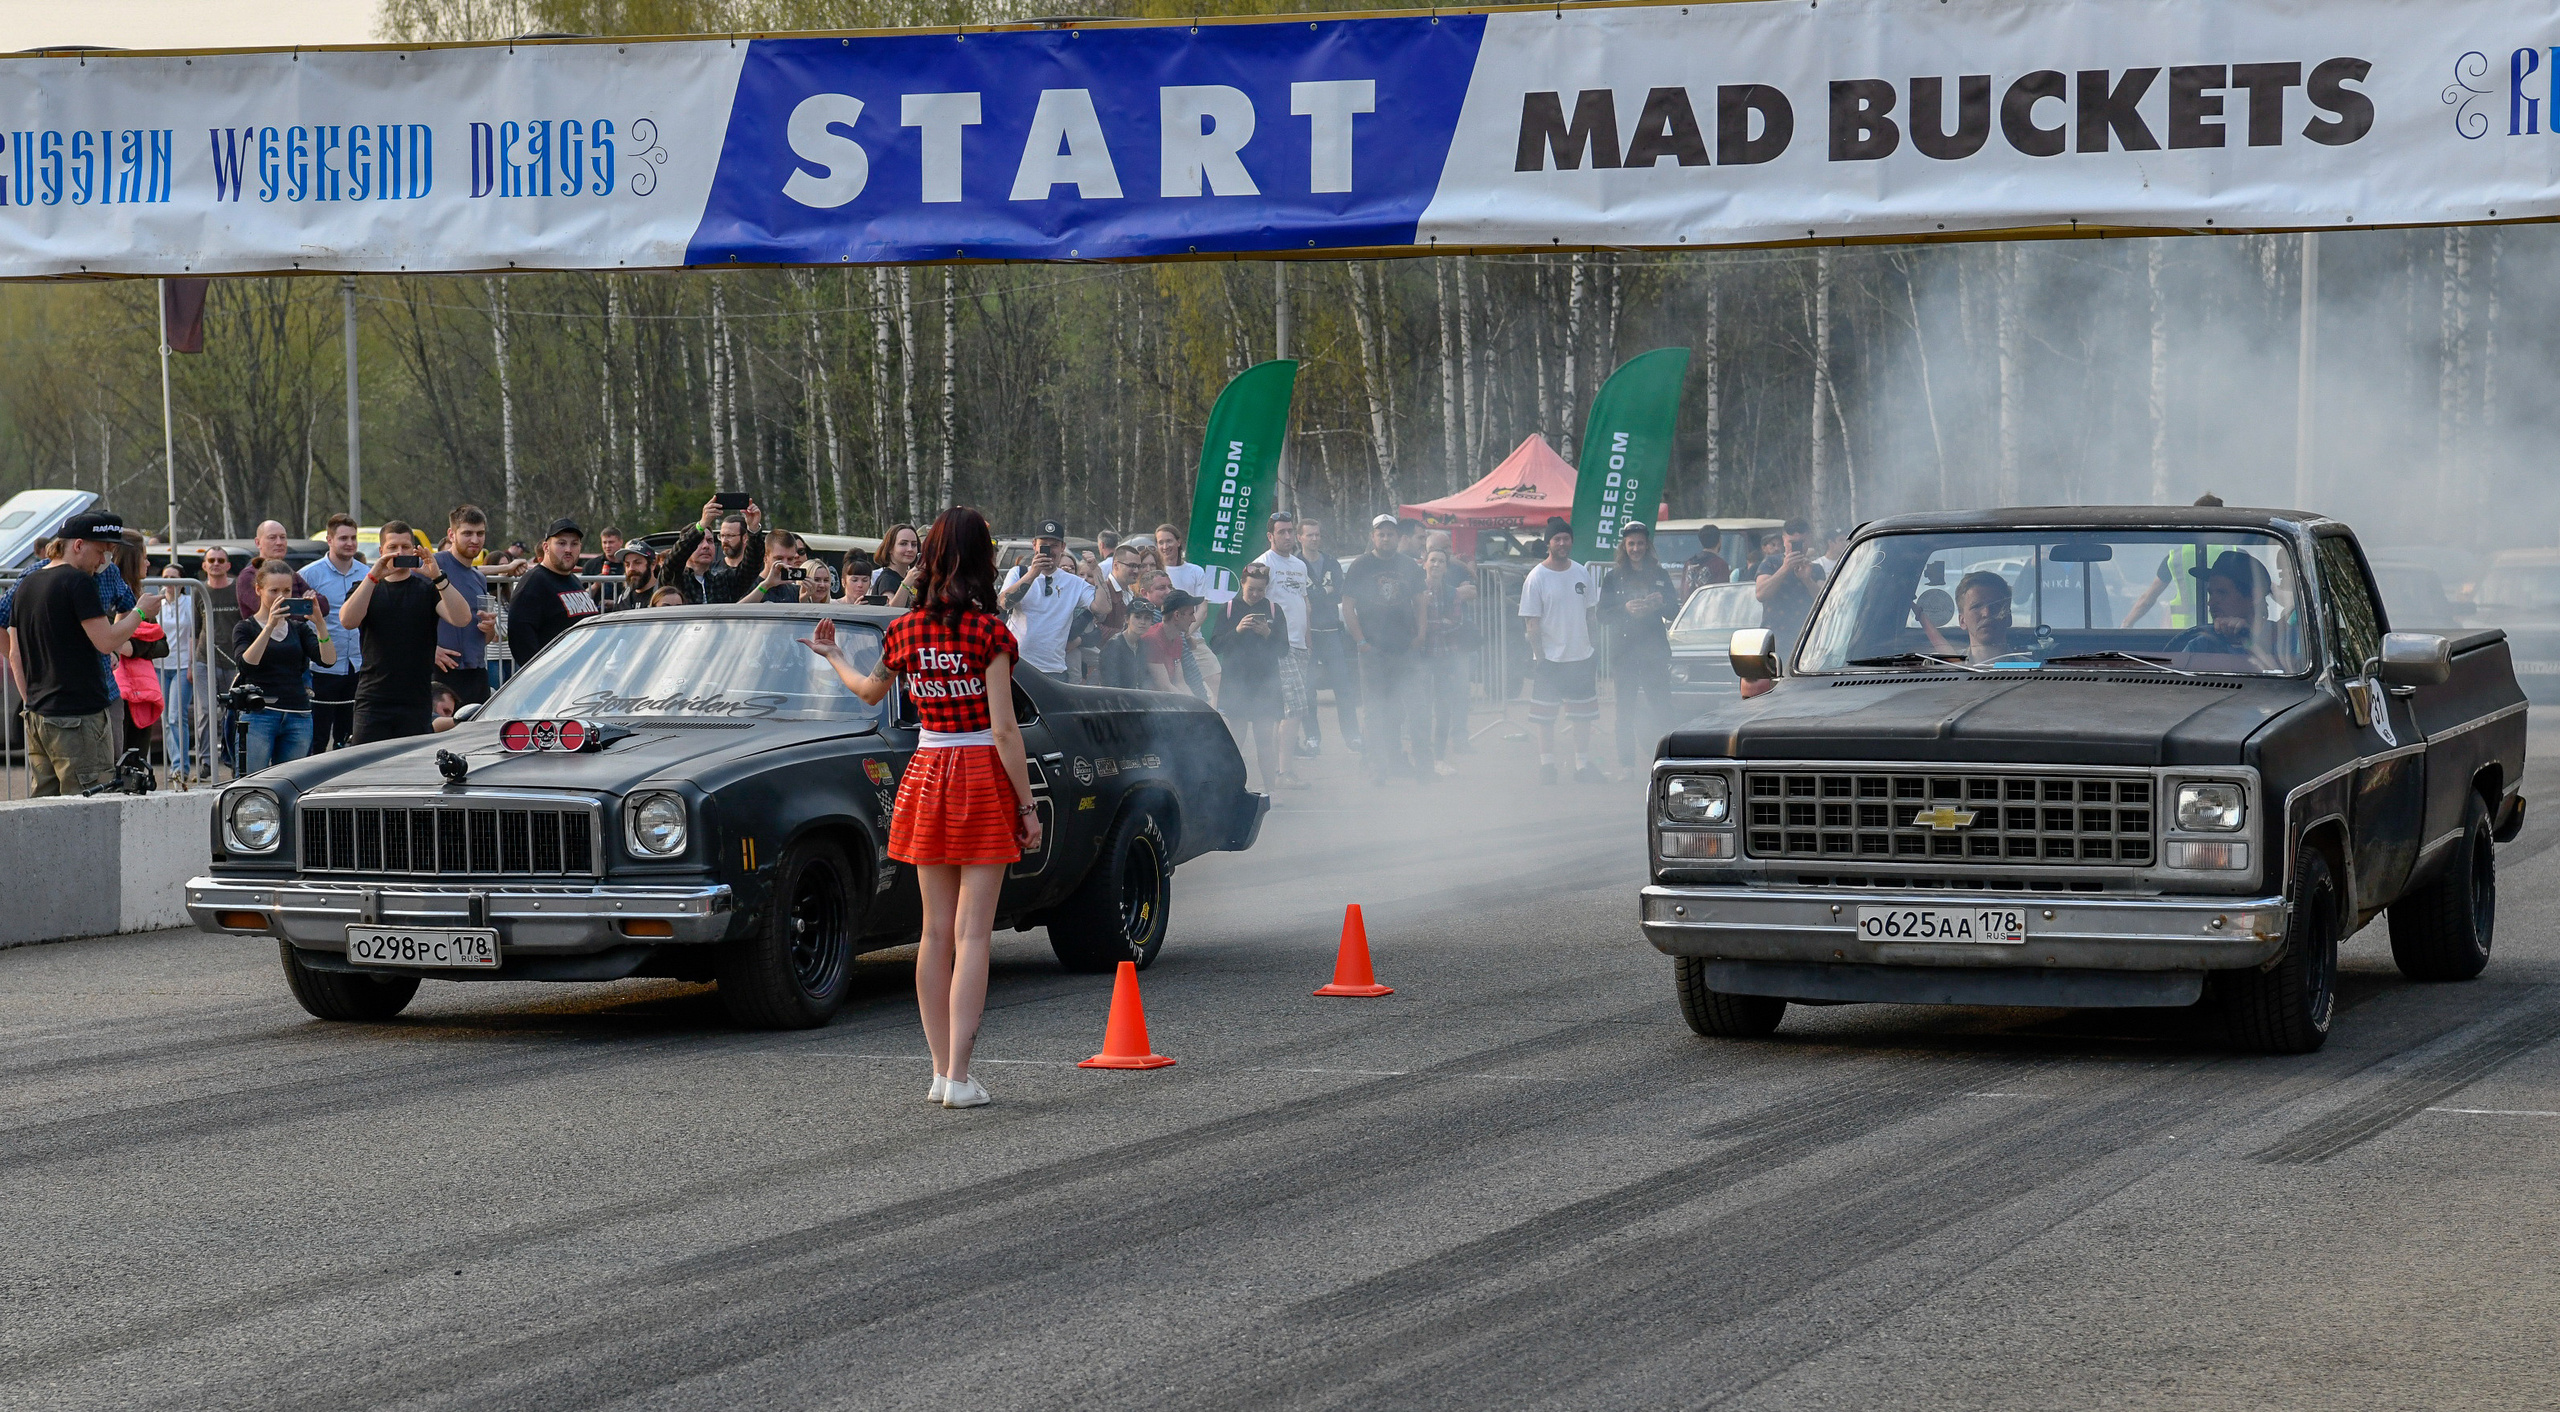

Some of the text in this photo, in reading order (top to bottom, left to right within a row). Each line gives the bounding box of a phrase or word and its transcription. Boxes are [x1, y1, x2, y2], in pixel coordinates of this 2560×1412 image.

[1514, 56, 2375, 173] MAD BUCKETS
[781, 78, 1377, 209] START
[0, 118, 616, 207] USSIAN WEEKEND DRAGS
[1211, 440, 1244, 554] FREEDOM
[1595, 431, 1630, 550] FREEDOM
[1227, 485, 1252, 555] finance
[2042, 579, 2070, 589] NIKE
[917, 647, 968, 675] Hey,
[947, 676, 986, 698] me.
[1978, 911, 2017, 932] 178
[452, 936, 488, 956] 178
[1986, 931, 2006, 941] RUS
[461, 954, 480, 963] RUS
